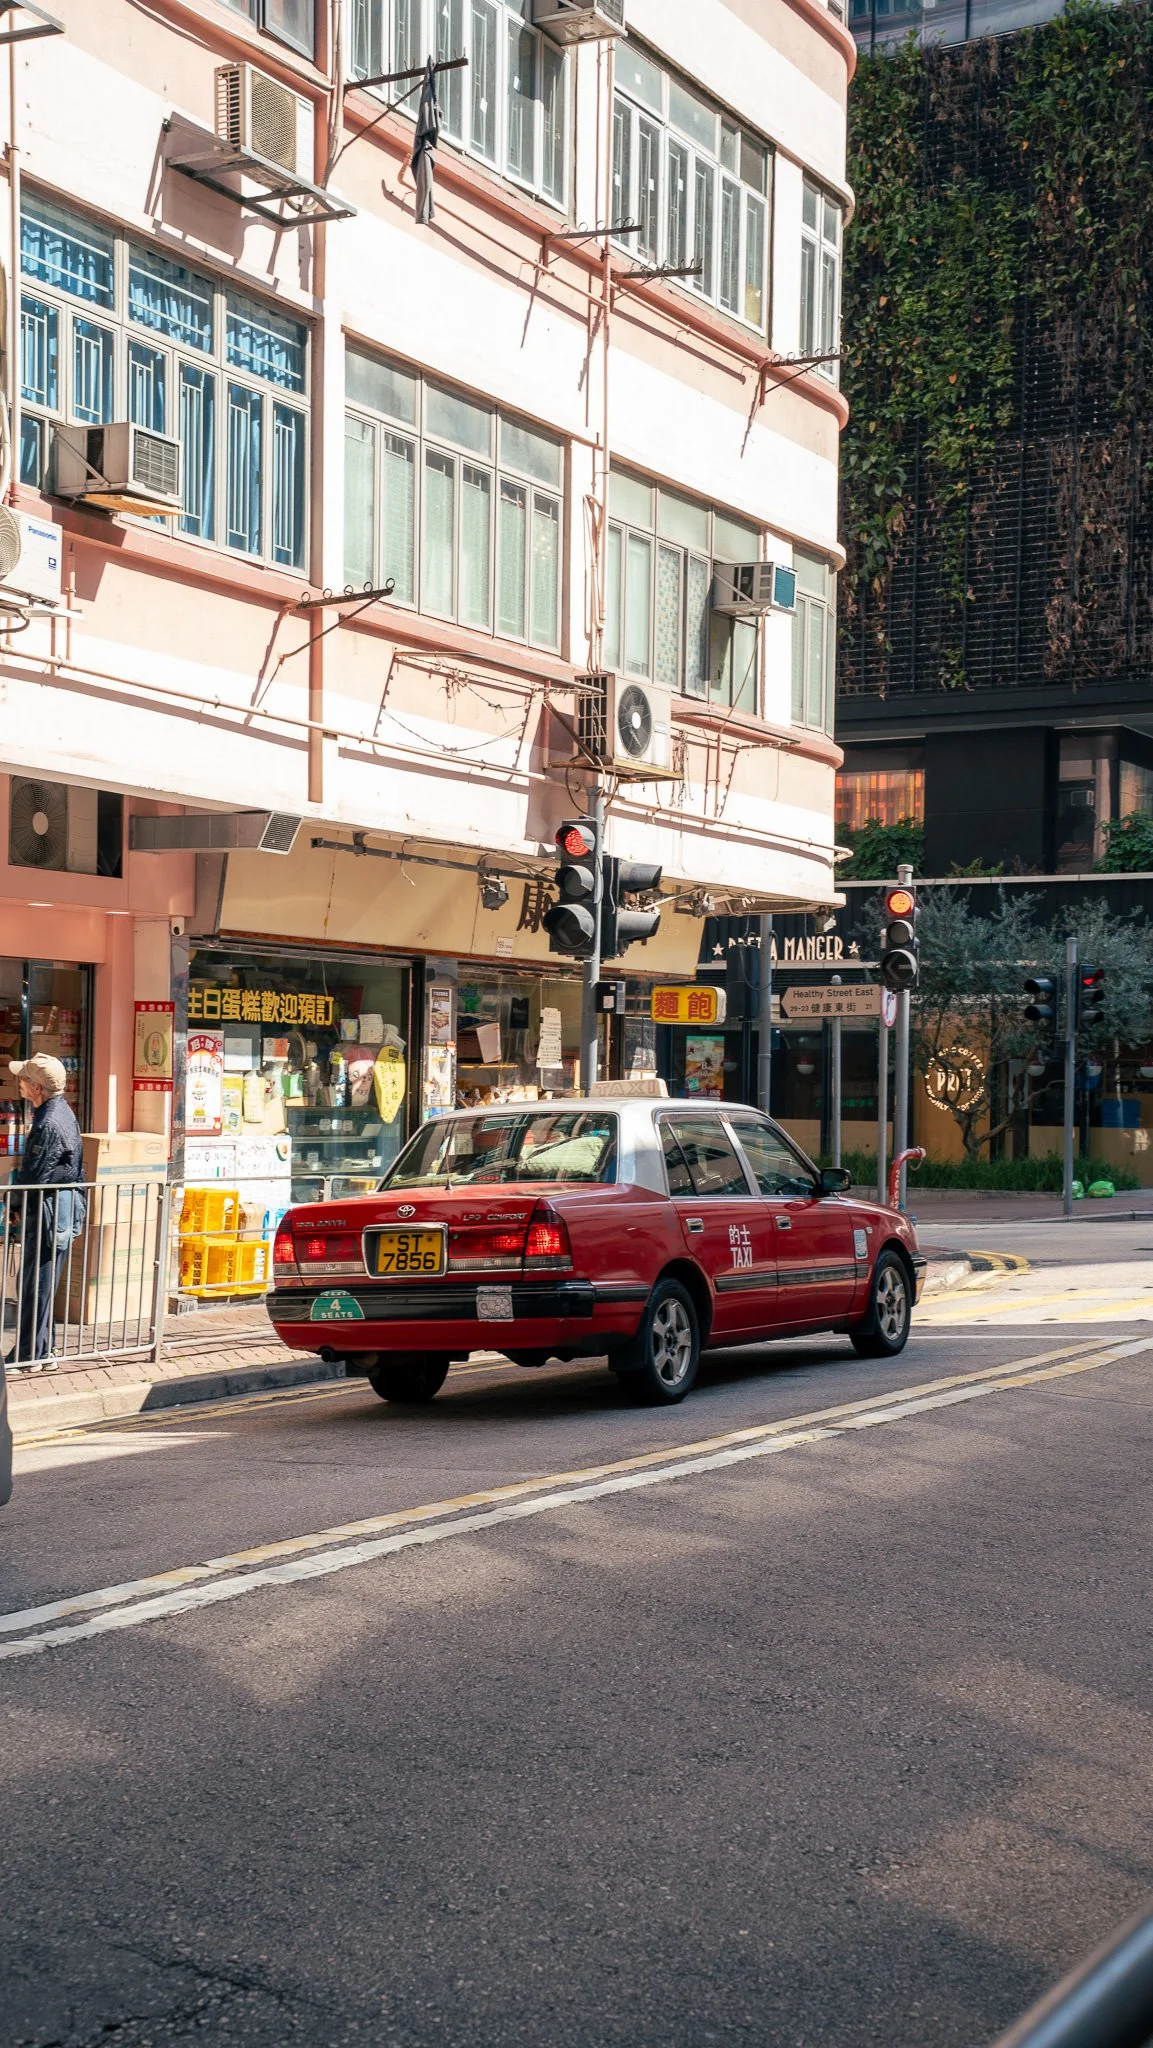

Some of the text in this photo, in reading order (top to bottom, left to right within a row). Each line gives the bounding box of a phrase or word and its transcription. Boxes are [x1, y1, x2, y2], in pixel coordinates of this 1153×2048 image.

[784, 936, 843, 960] MANGER
[793, 987, 874, 999] Healthy Street East
[811, 1002, 857, 1013] 健康東街
[596, 1080, 656, 1096] TAXI
[487, 1212, 527, 1221] COMFORT
[729, 1224, 751, 1245] 的士
[397, 1234, 424, 1252] ST
[384, 1251, 436, 1270] 7856
[730, 1246, 753, 1268] TAXI
[330, 1298, 341, 1311] 4
[321, 1311, 353, 1319] SEATS
